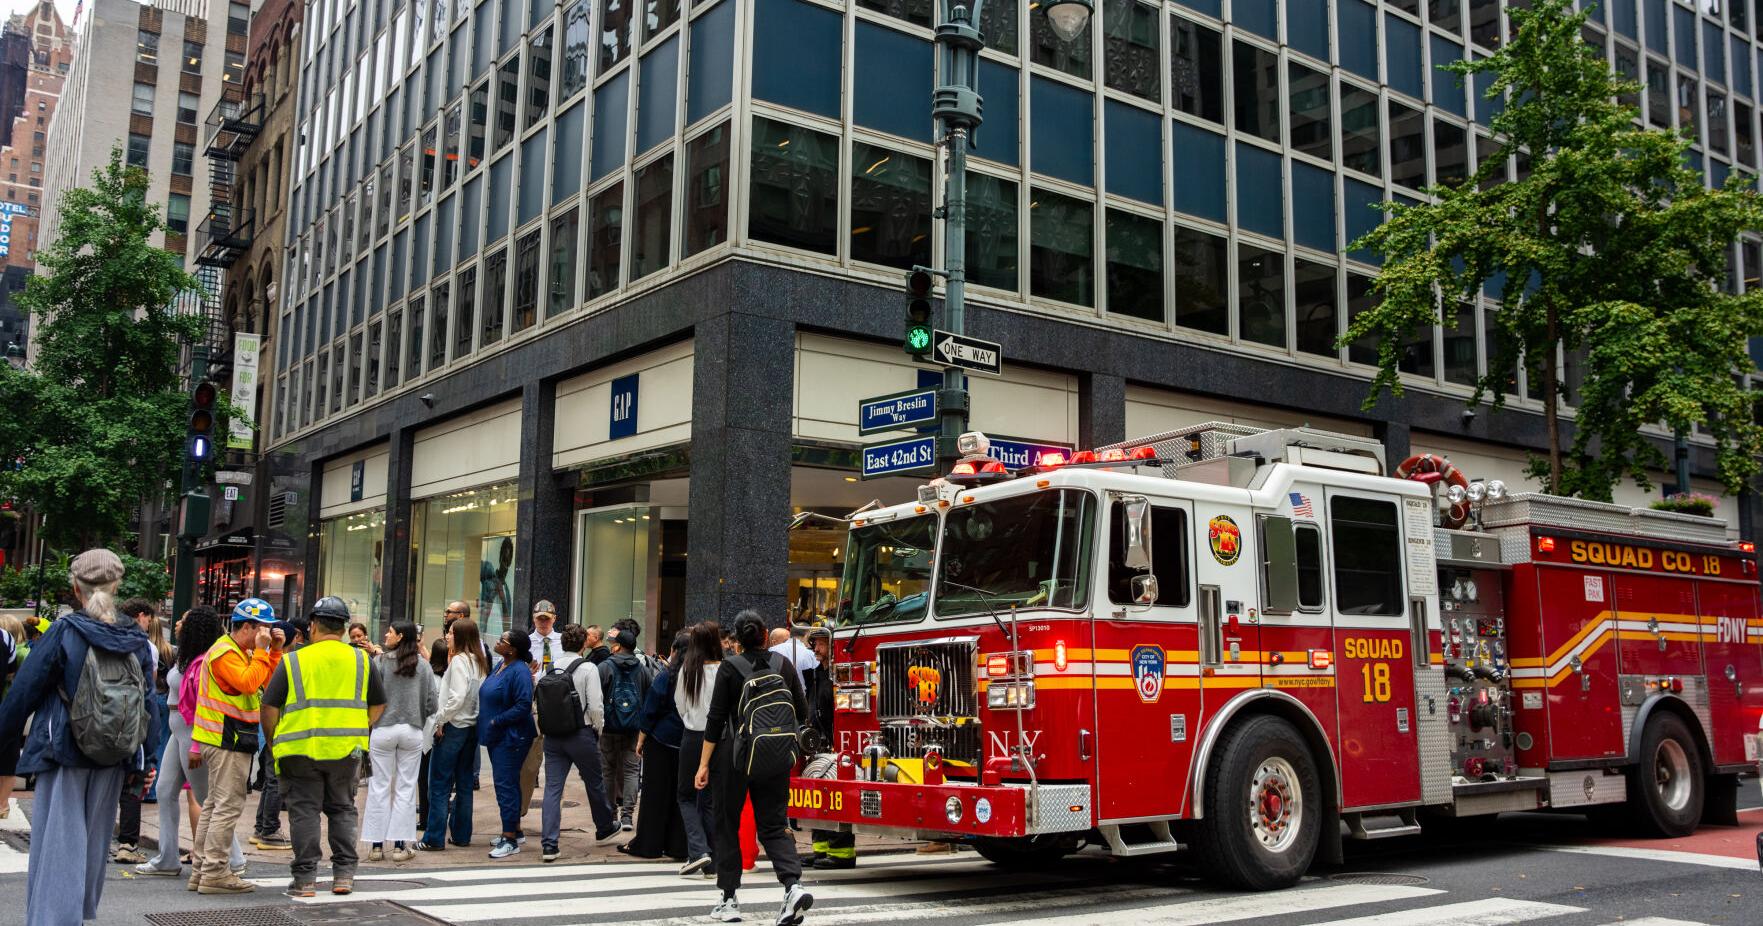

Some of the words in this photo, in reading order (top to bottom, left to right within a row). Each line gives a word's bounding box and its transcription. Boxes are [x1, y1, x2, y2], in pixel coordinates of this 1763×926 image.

[944, 343, 963, 358] ONE
[972, 349, 992, 363] WAY
[239, 371, 252, 384] FOR
[614, 391, 631, 422] GAP
[869, 405, 895, 419] Jimmy
[897, 398, 927, 412] Breslin
[892, 413, 906, 422] Way
[867, 454, 888, 470] East
[892, 447, 916, 466] 42nd
[920, 445, 931, 462] St
[989, 446, 1029, 466] Third
[226, 488, 236, 498] EAT
[1571, 540, 1653, 569] SQUAD
[1662, 551, 1696, 572] CO.
[1702, 555, 1720, 575] 18
[1585, 577, 1601, 587] FAST
[1587, 589, 1600, 599] PAK
[1717, 616, 1746, 643] FDNY
[1344, 637, 1403, 659] SQUAD
[1362, 662, 1391, 703] 18
[829, 790, 843, 811] 18
